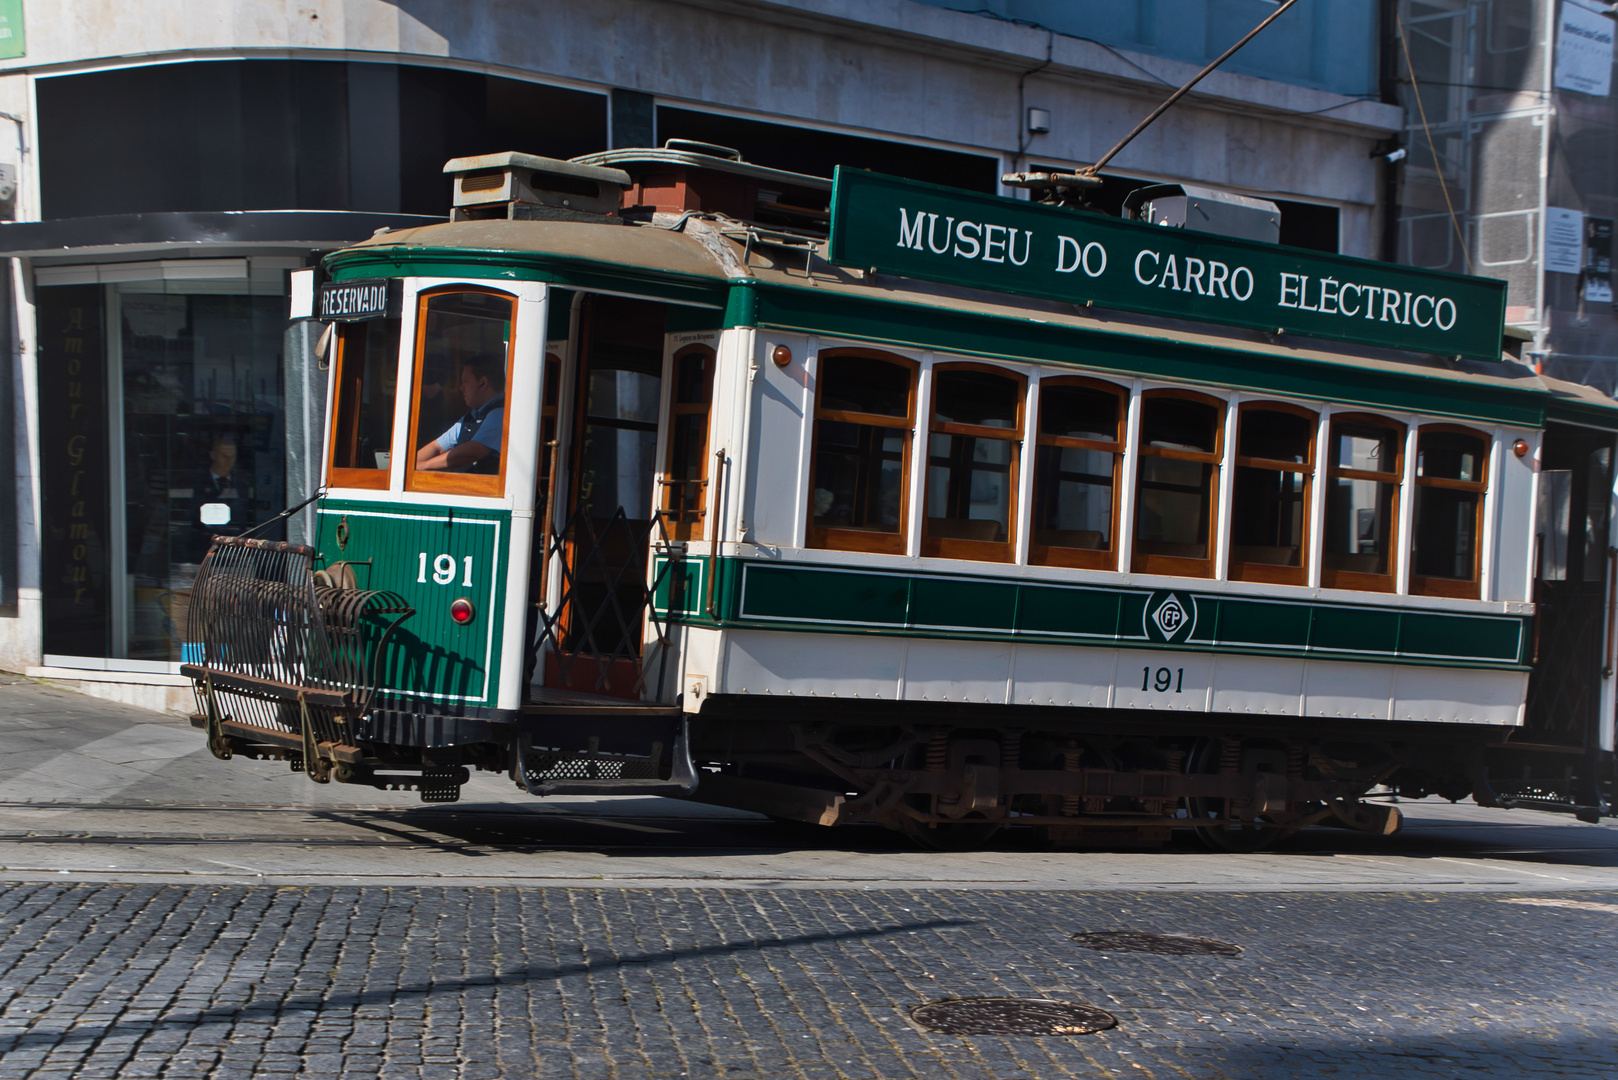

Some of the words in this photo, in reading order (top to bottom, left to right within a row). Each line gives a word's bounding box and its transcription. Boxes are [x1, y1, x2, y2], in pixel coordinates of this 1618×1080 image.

[322, 285, 386, 315] RESERVADO
[897, 207, 1032, 266] MUSEU
[1055, 235, 1107, 277] DO
[1134, 249, 1254, 301] CARRO
[1278, 272, 1457, 331] ELÉCTRICO
[62, 307, 83, 419] Amour
[67, 435, 88, 604] Glamour
[417, 552, 473, 587] 191
[1141, 666, 1184, 693] 191
